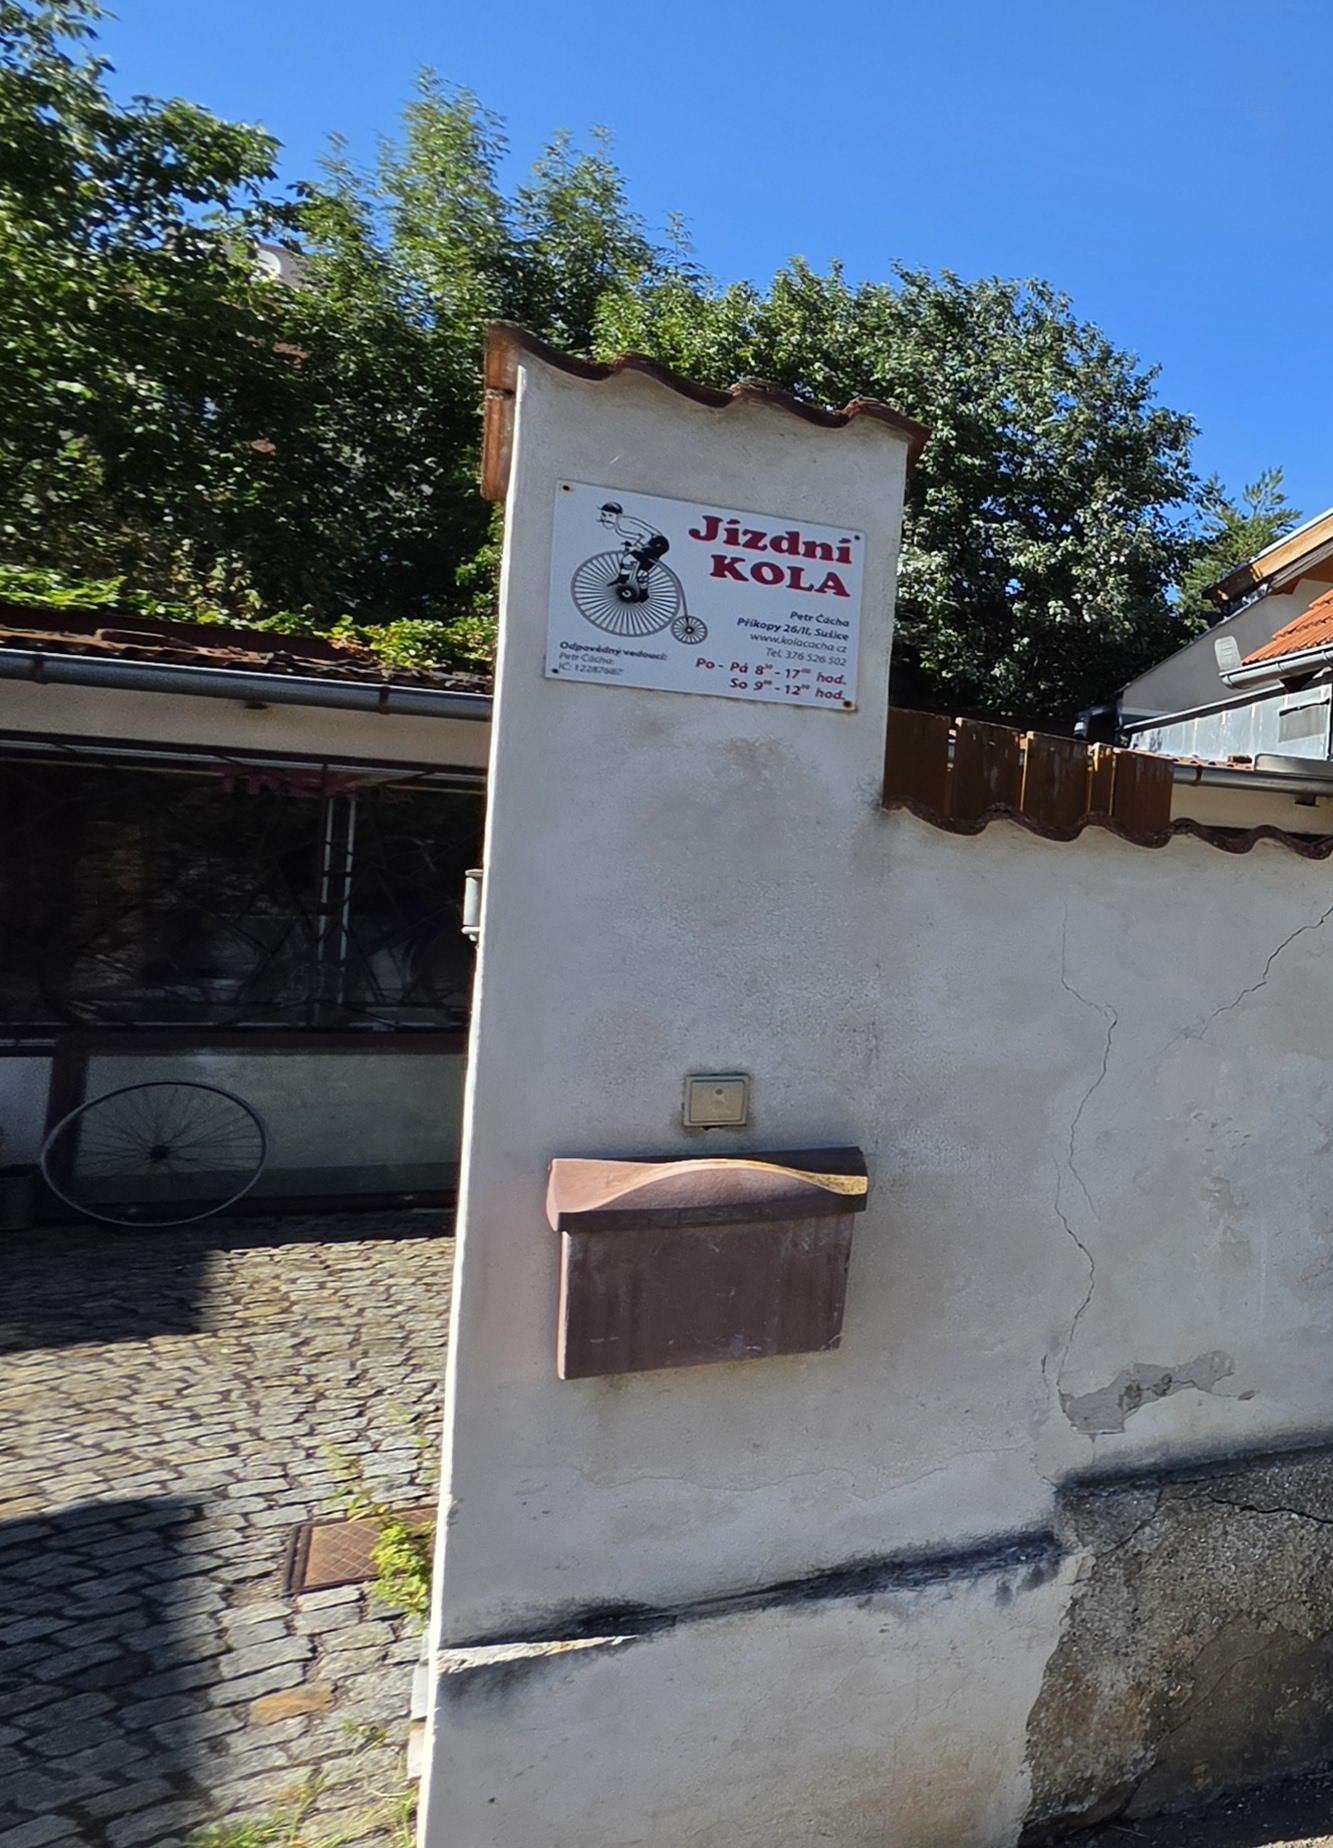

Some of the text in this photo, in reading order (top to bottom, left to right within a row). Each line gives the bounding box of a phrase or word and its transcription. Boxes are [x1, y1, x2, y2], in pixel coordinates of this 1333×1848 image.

[709, 554, 851, 597] KOLA
[790, 611, 814, 622] Petr
[737, 617, 782, 633] Příkopy
[814, 628, 849, 641] Sušice
[785, 650, 805, 661] 376
[807, 653, 827, 664] 526
[828, 656, 847, 667] 502
[695, 657, 716, 670] Po
[729, 661, 749, 673] Pá
[816, 671, 847, 686] hod.
[729, 677, 748, 690] So
[815, 687, 846, 701] hod.
